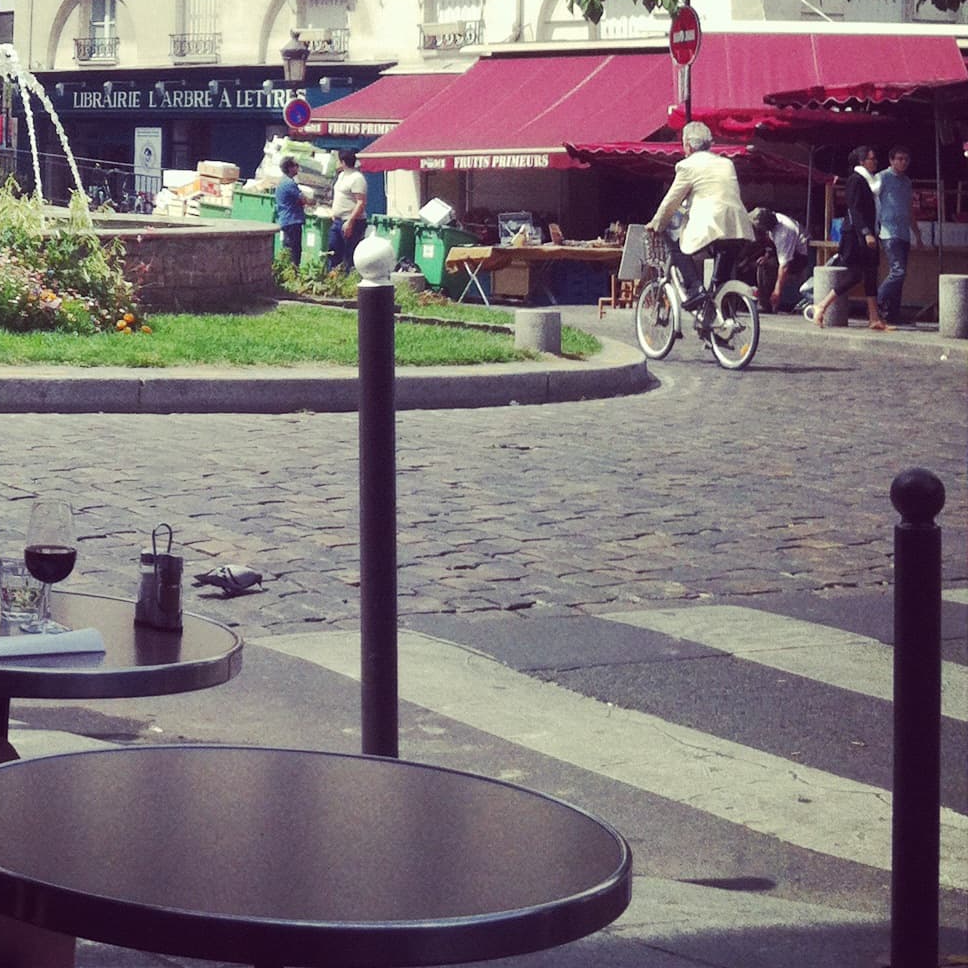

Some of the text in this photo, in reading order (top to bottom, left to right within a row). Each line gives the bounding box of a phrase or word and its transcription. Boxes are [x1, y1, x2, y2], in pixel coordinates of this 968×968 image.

[73, 90, 141, 109] LIBRAIRIE
[149, 90, 213, 108] LARBRE
[328, 122, 360, 135] FRUITS
[453, 155, 490, 169] FRUITS
[491, 154, 549, 169] PRIMEURS
